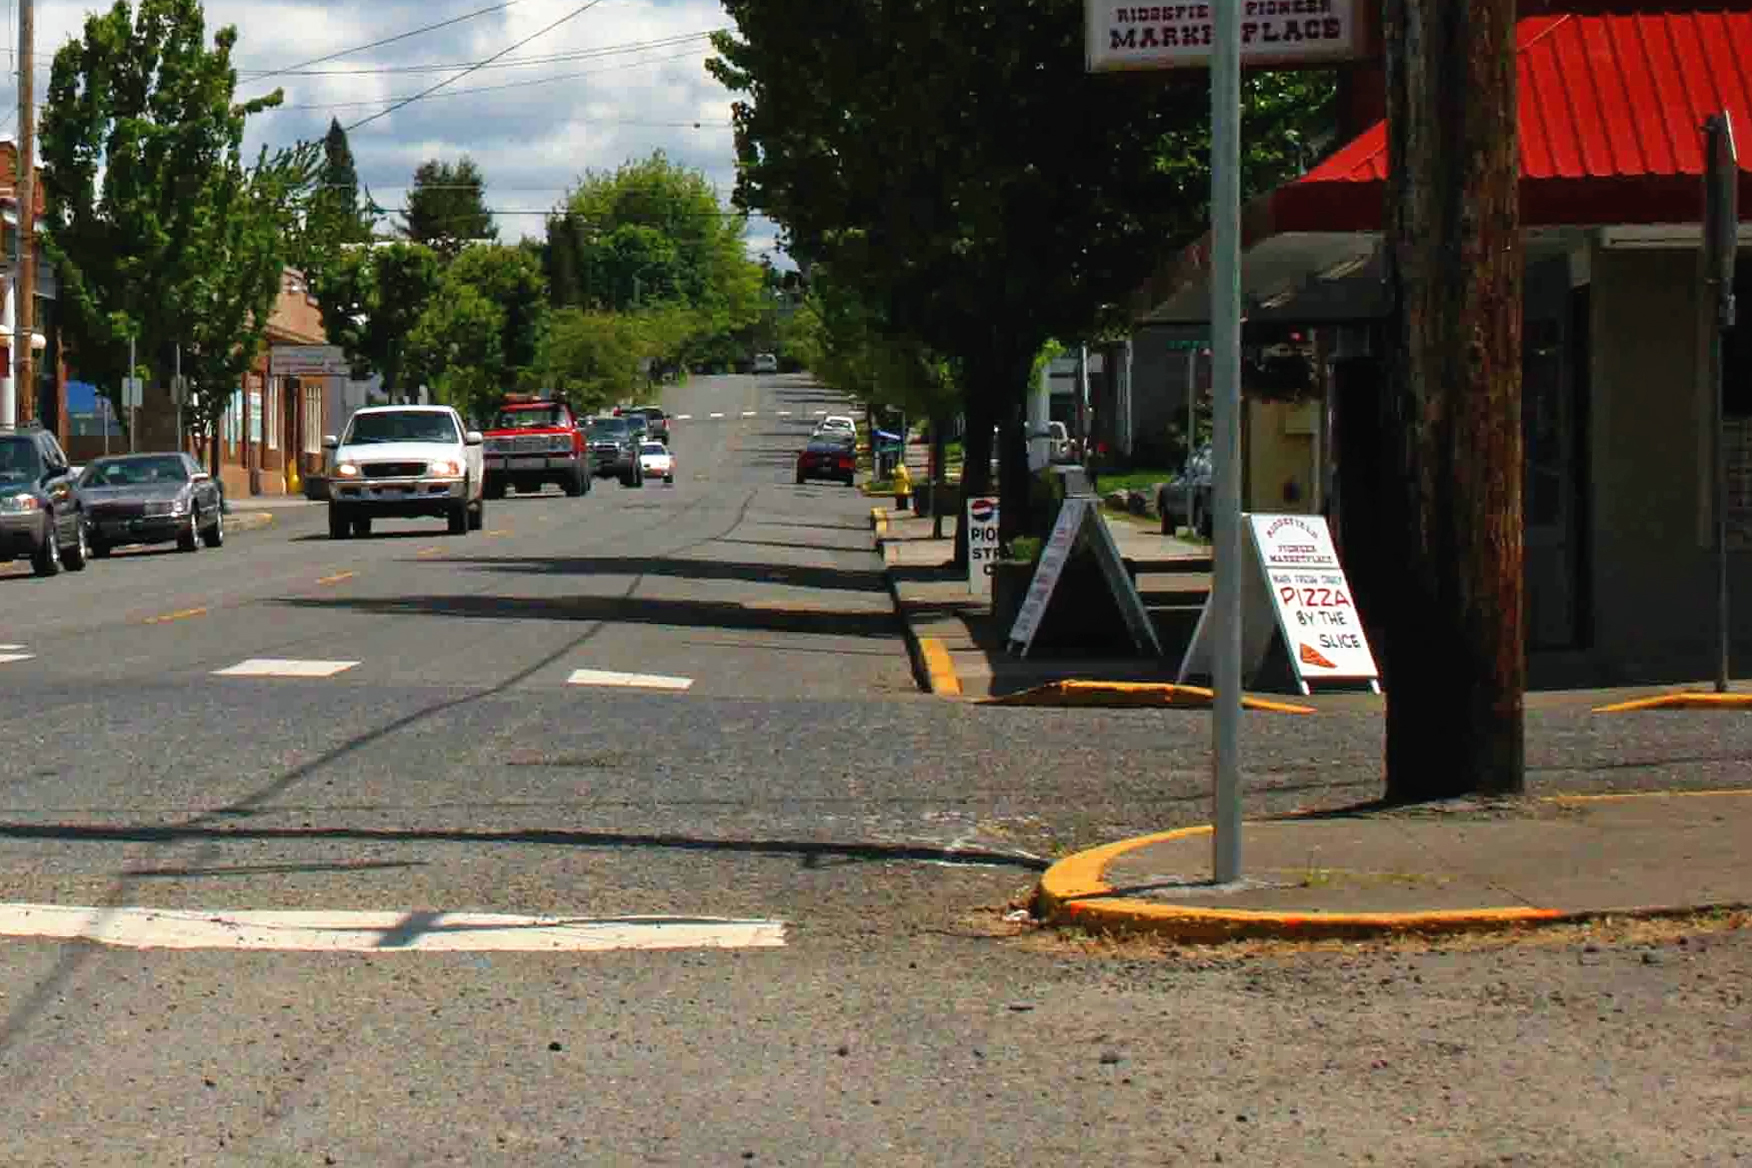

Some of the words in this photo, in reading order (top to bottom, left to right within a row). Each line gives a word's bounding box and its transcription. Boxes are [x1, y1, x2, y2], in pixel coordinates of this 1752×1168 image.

[1116, 5, 1209, 23] RIDGEFIE
[1280, 586, 1351, 607] PIZZA
[1296, 610, 1315, 625] BY
[1318, 611, 1347, 625] THE
[1319, 634, 1361, 649] SLICE
